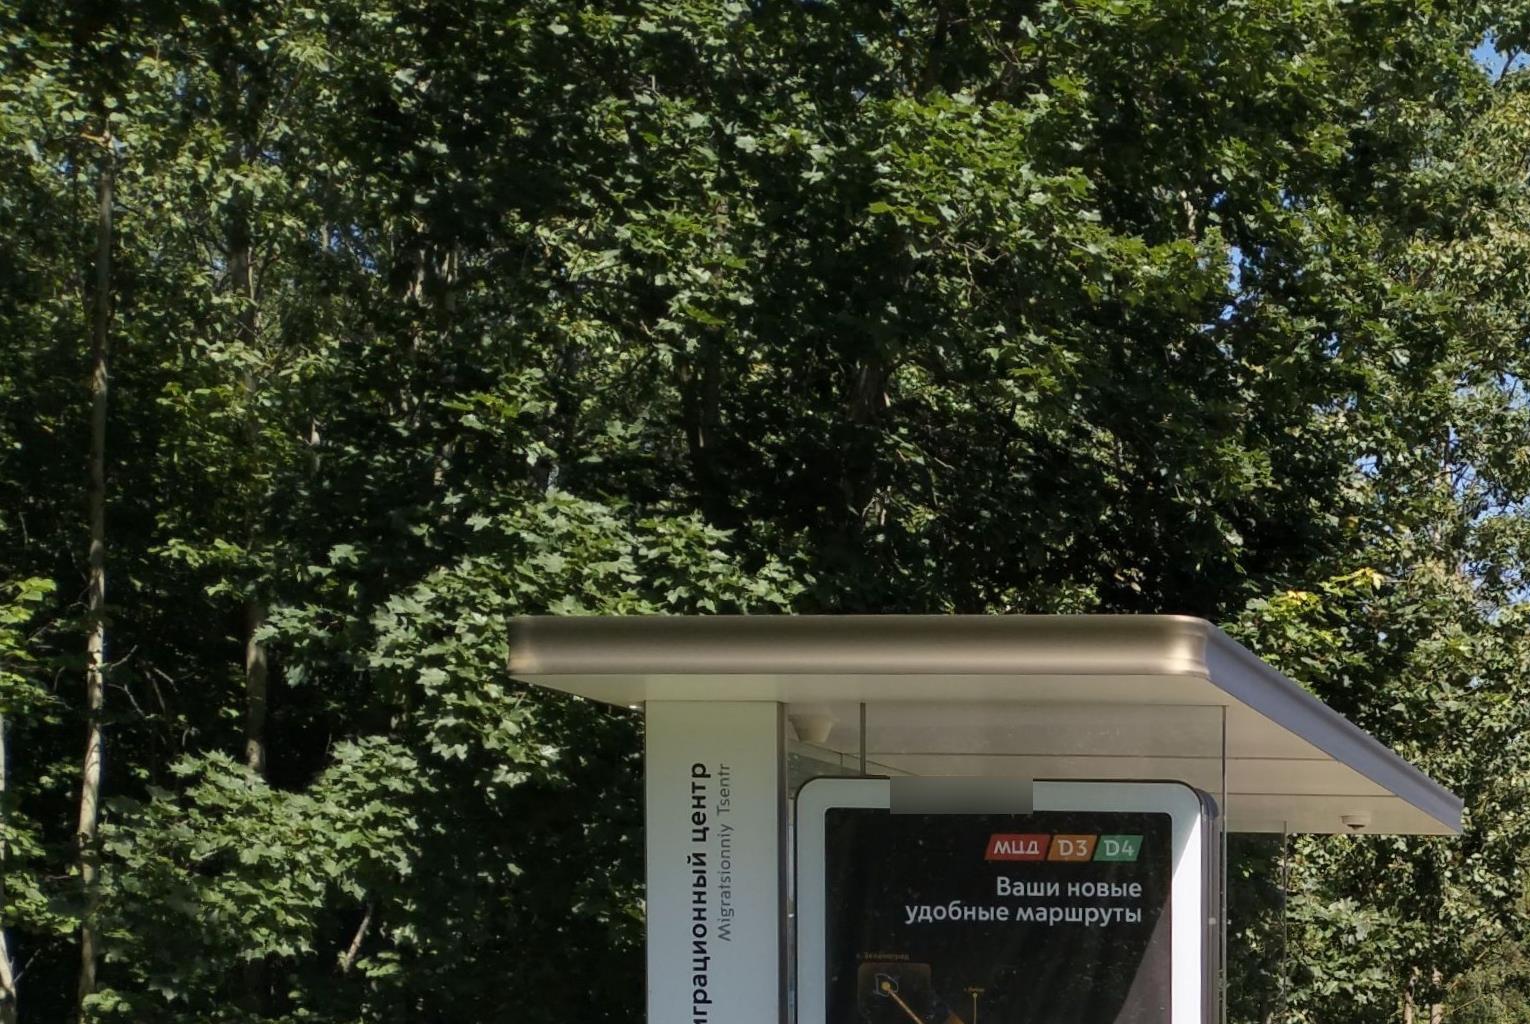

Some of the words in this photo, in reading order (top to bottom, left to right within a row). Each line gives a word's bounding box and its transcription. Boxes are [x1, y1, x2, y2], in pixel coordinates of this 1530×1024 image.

[691, 762, 711, 842] центр
[716, 763, 731, 816] Tsentr
[993, 839, 1040, 855] МЦД
[1057, 839, 1089, 857] D3
[1103, 839, 1134, 857] D4
[716, 823, 735, 942] Migratsionniy
[996, 876, 1060, 897] Ваши
[1067, 881, 1143, 898] новые
[904, 900, 1009, 925] удобные
[1015, 906, 1142, 927] маршруты
